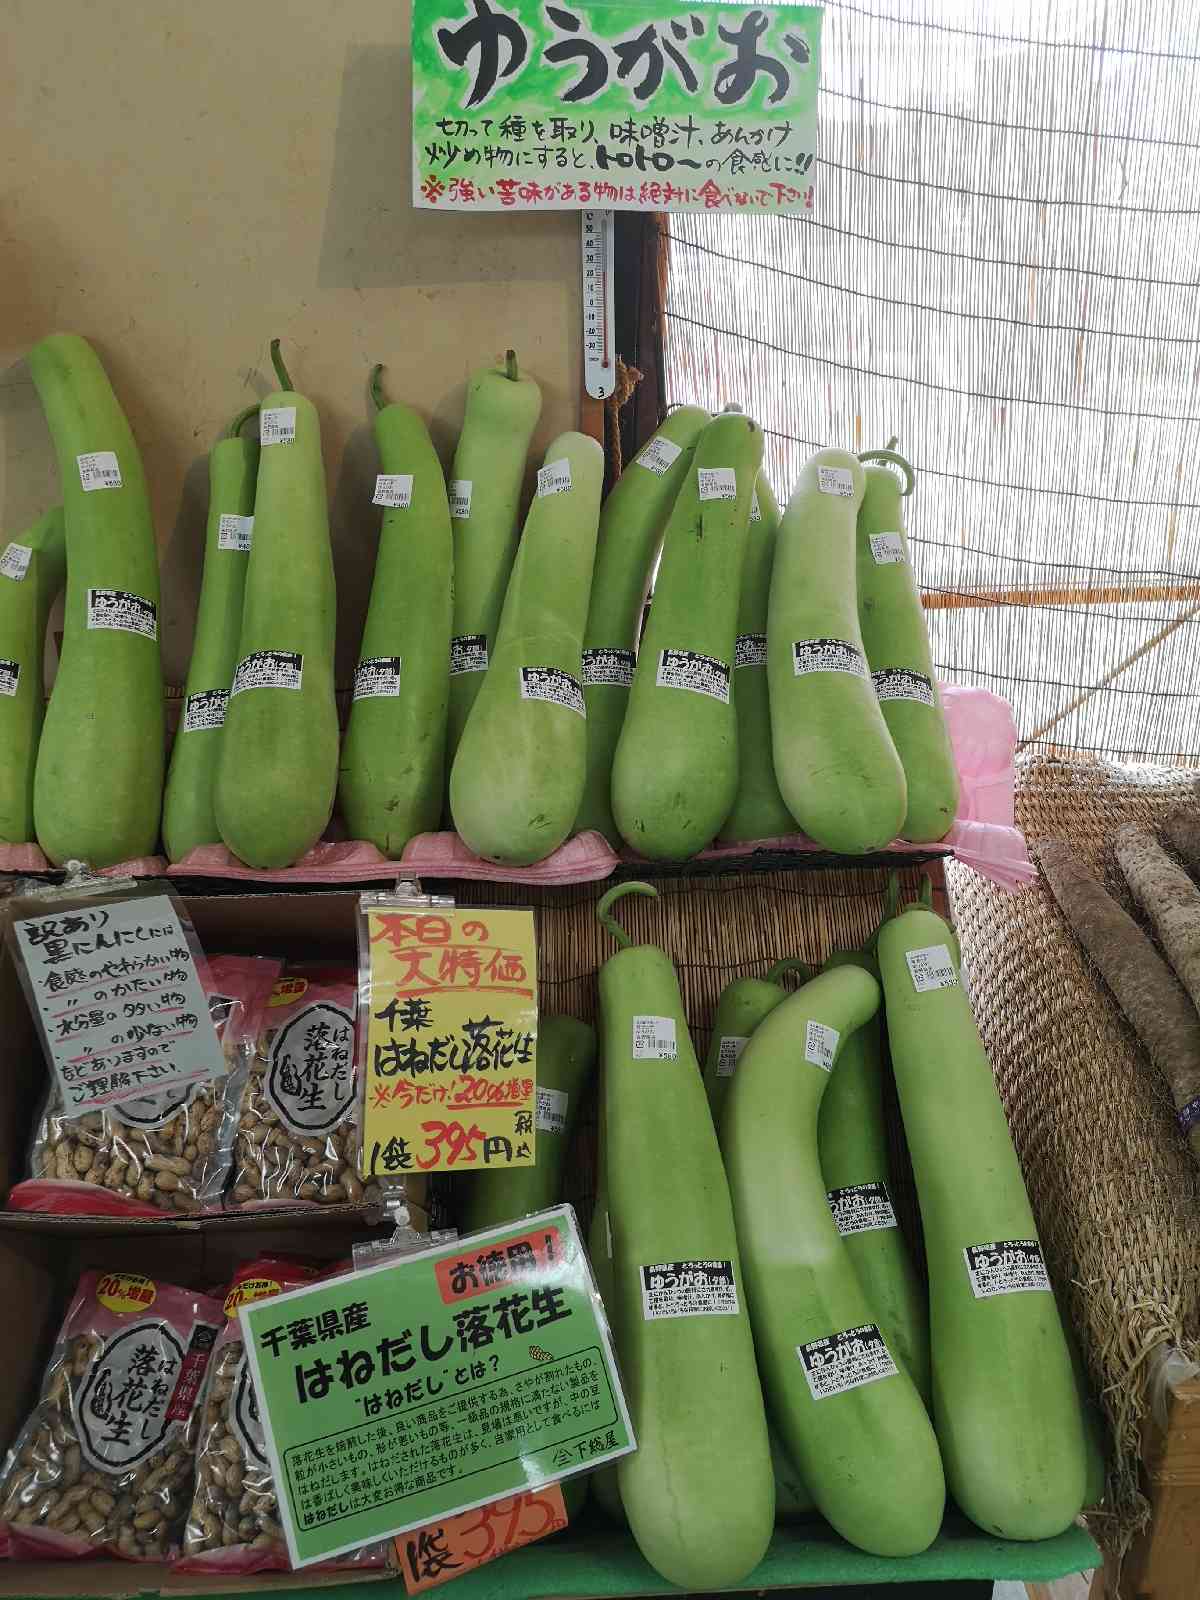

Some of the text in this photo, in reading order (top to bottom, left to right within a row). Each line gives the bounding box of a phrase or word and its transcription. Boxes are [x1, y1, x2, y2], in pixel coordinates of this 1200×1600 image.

[437, 0, 810, 108] ゆうがお
[24, 911, 109, 946] 訳あり
[370, 912, 489, 945] 本日の
[394, 950, 527, 987] 大特価
[374, 1015, 534, 1078] はねだし落花生
[375, 998, 432, 1032] 千葉
[297, 1021, 334, 1112] 落花生
[331, 1025, 350, 1101] はねだし
[260, 1301, 372, 1360] 千葉県産
[295, 1286, 573, 1404] はねだし落花生
[101, 1343, 160, 1446] 落花生
[141, 1357, 178, 1441] はねだし
